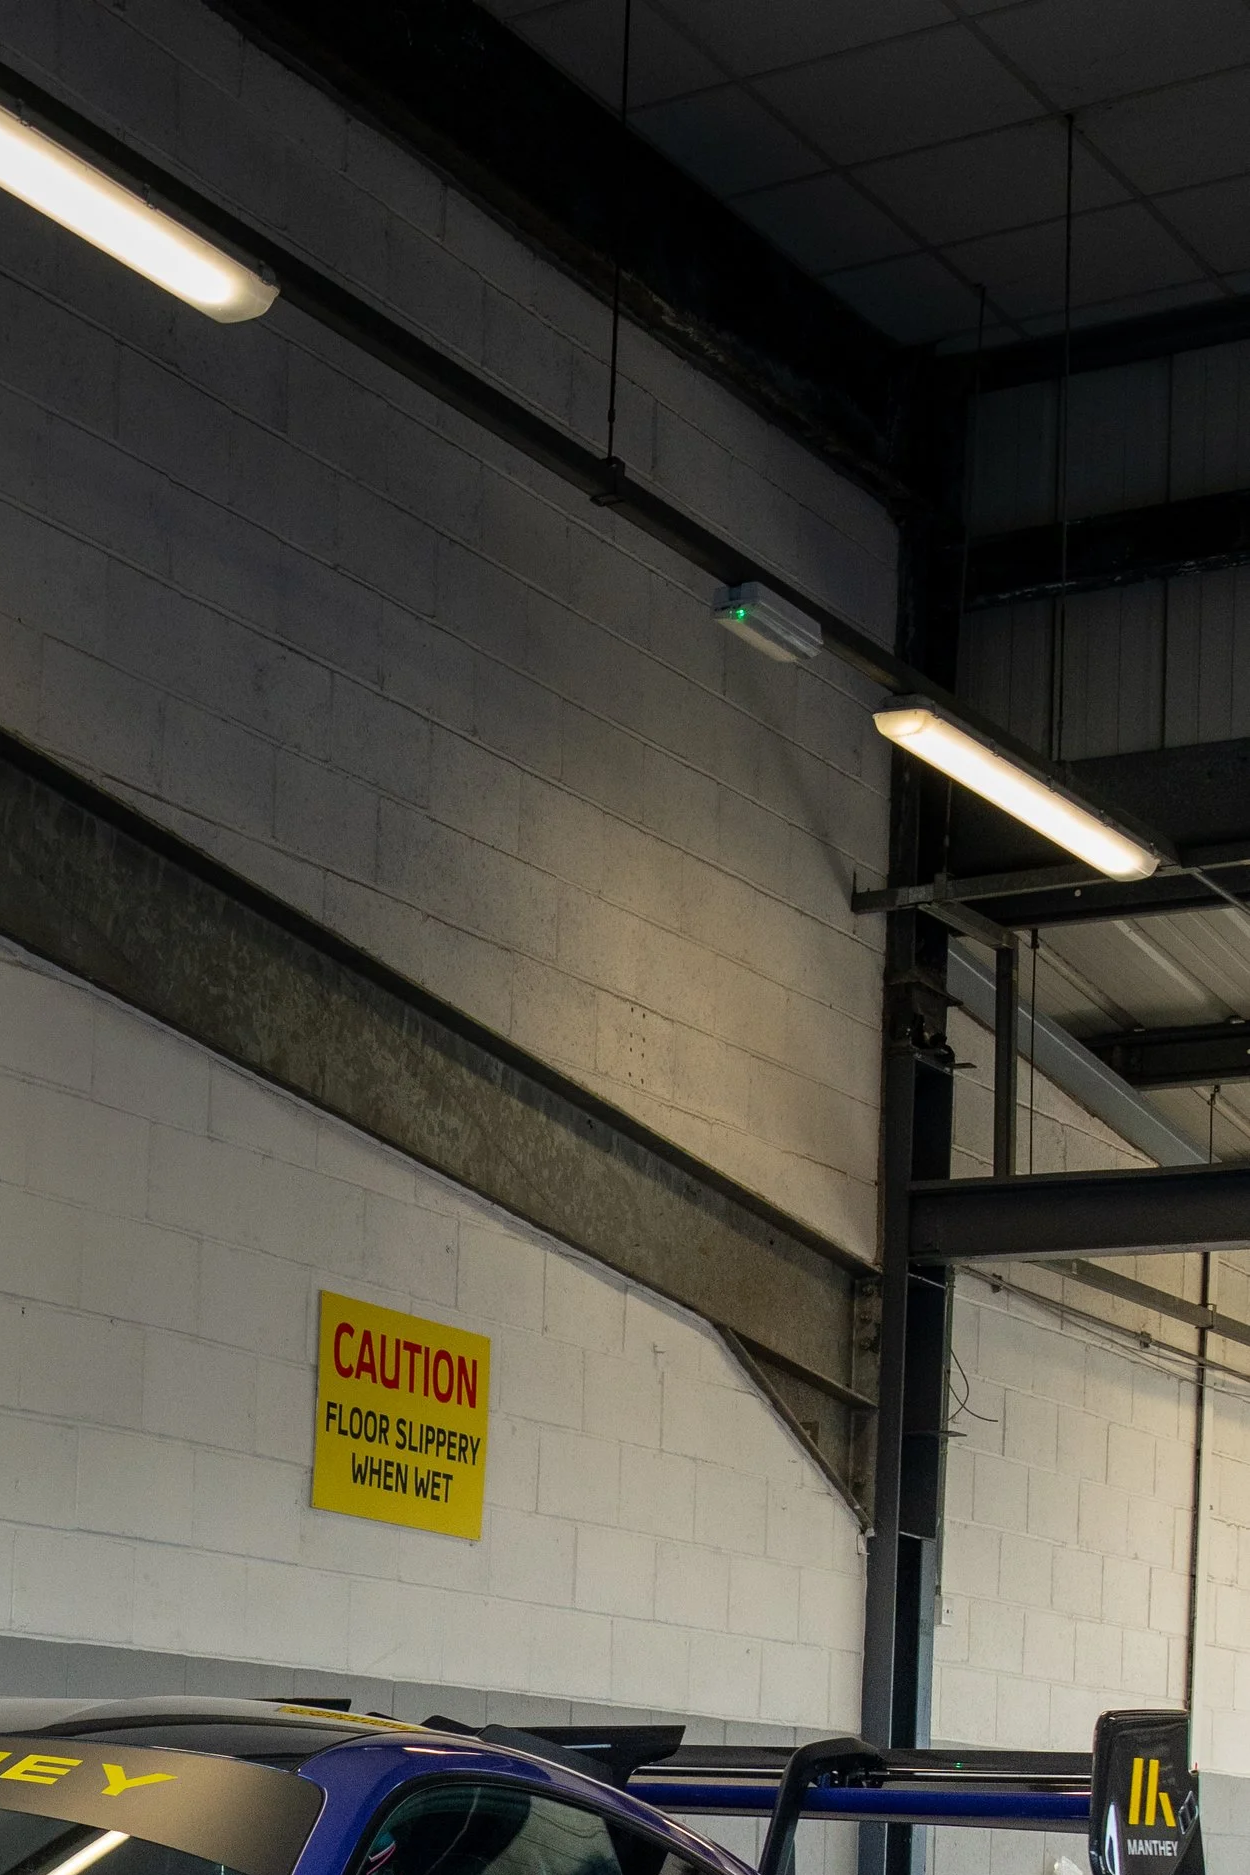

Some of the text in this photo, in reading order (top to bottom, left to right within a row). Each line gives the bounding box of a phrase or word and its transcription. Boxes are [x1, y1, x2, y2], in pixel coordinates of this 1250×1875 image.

[333, 1322, 478, 1409] CAUTION
[325, 1400, 481, 1466] FLOOR SLIPPERY
[351, 1452, 454, 1503] WHEN WET
[1126, 1838, 1179, 1858] MANTHEY
